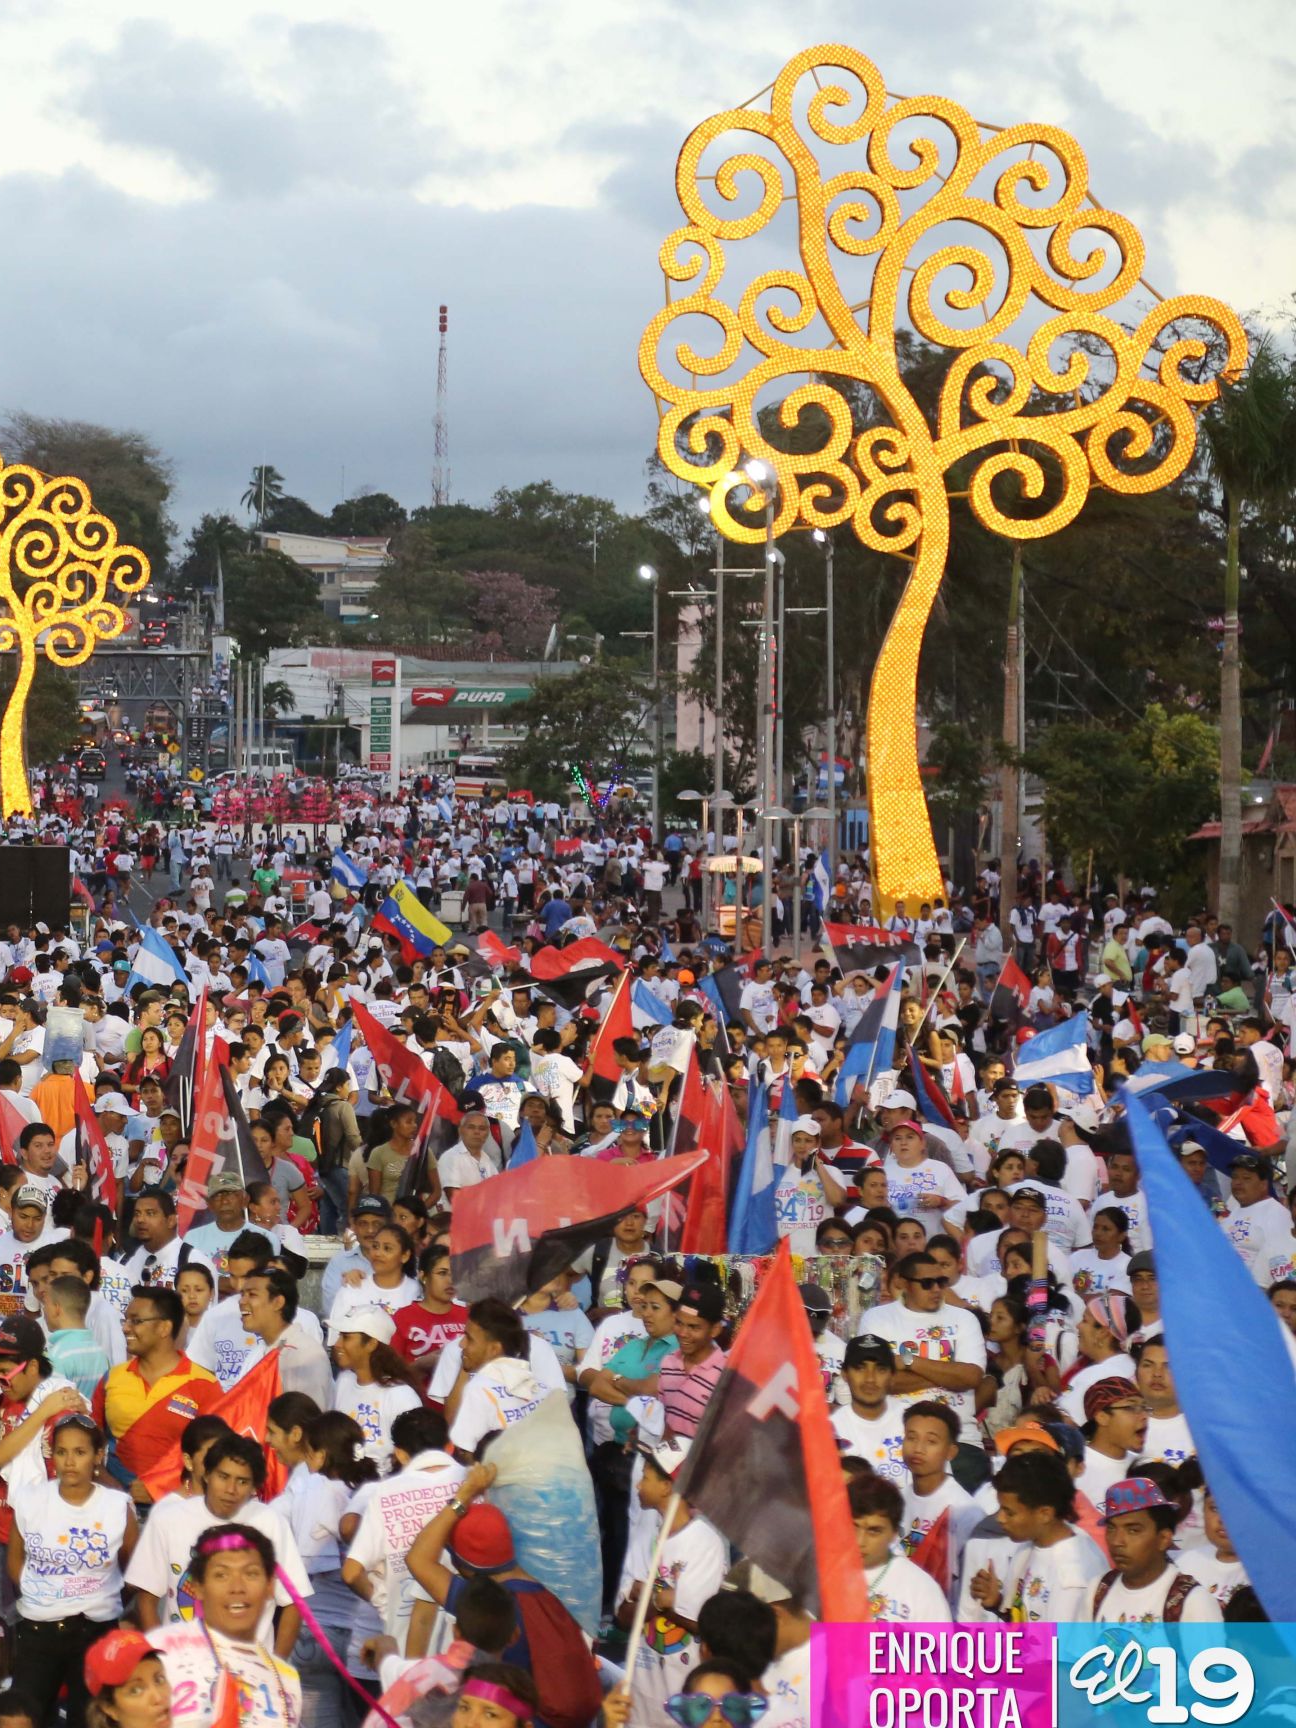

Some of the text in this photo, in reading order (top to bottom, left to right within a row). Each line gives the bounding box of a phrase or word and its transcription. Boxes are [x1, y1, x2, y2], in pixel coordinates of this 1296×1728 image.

[454, 691, 506, 703] PUMA
[845, 931, 903, 949] FSLN
[808, 1205, 824, 1221] 19
[504, 1398, 544, 1423] PATR
